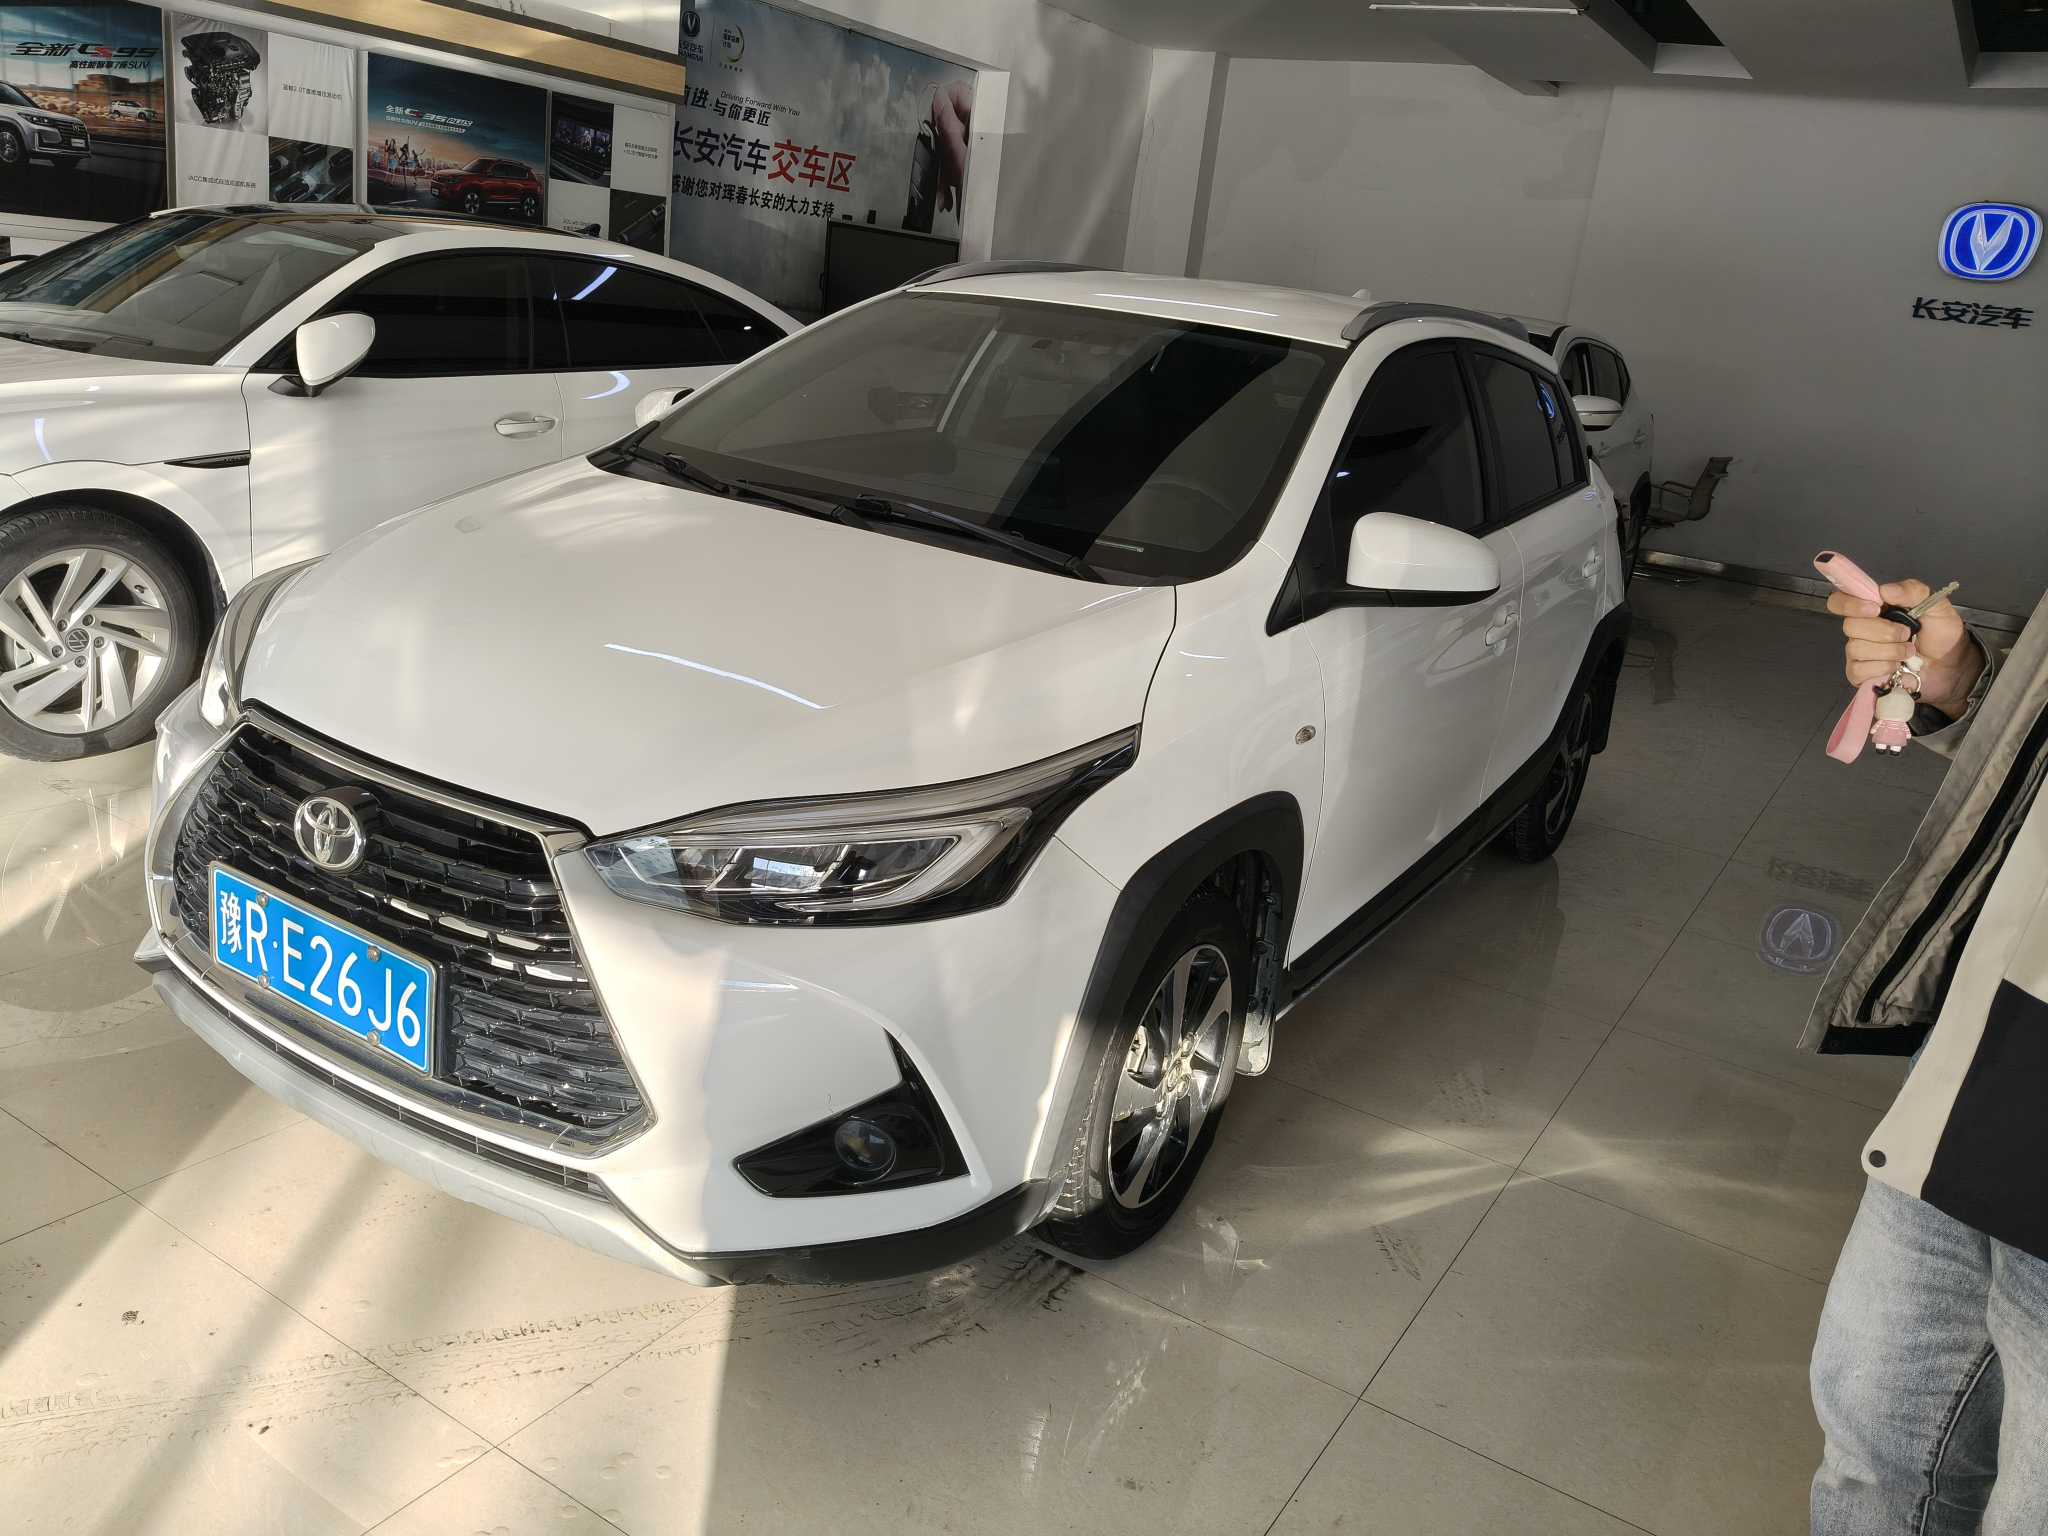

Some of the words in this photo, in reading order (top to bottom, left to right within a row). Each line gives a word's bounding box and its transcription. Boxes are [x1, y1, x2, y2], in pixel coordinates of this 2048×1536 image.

[720, 90, 744, 104] Driving
[745, 96, 772, 110] Forward
[772, 104, 789, 113] With
[788, 107, 801, 117] You
[1912, 296, 2035, 329] 长安汽车
